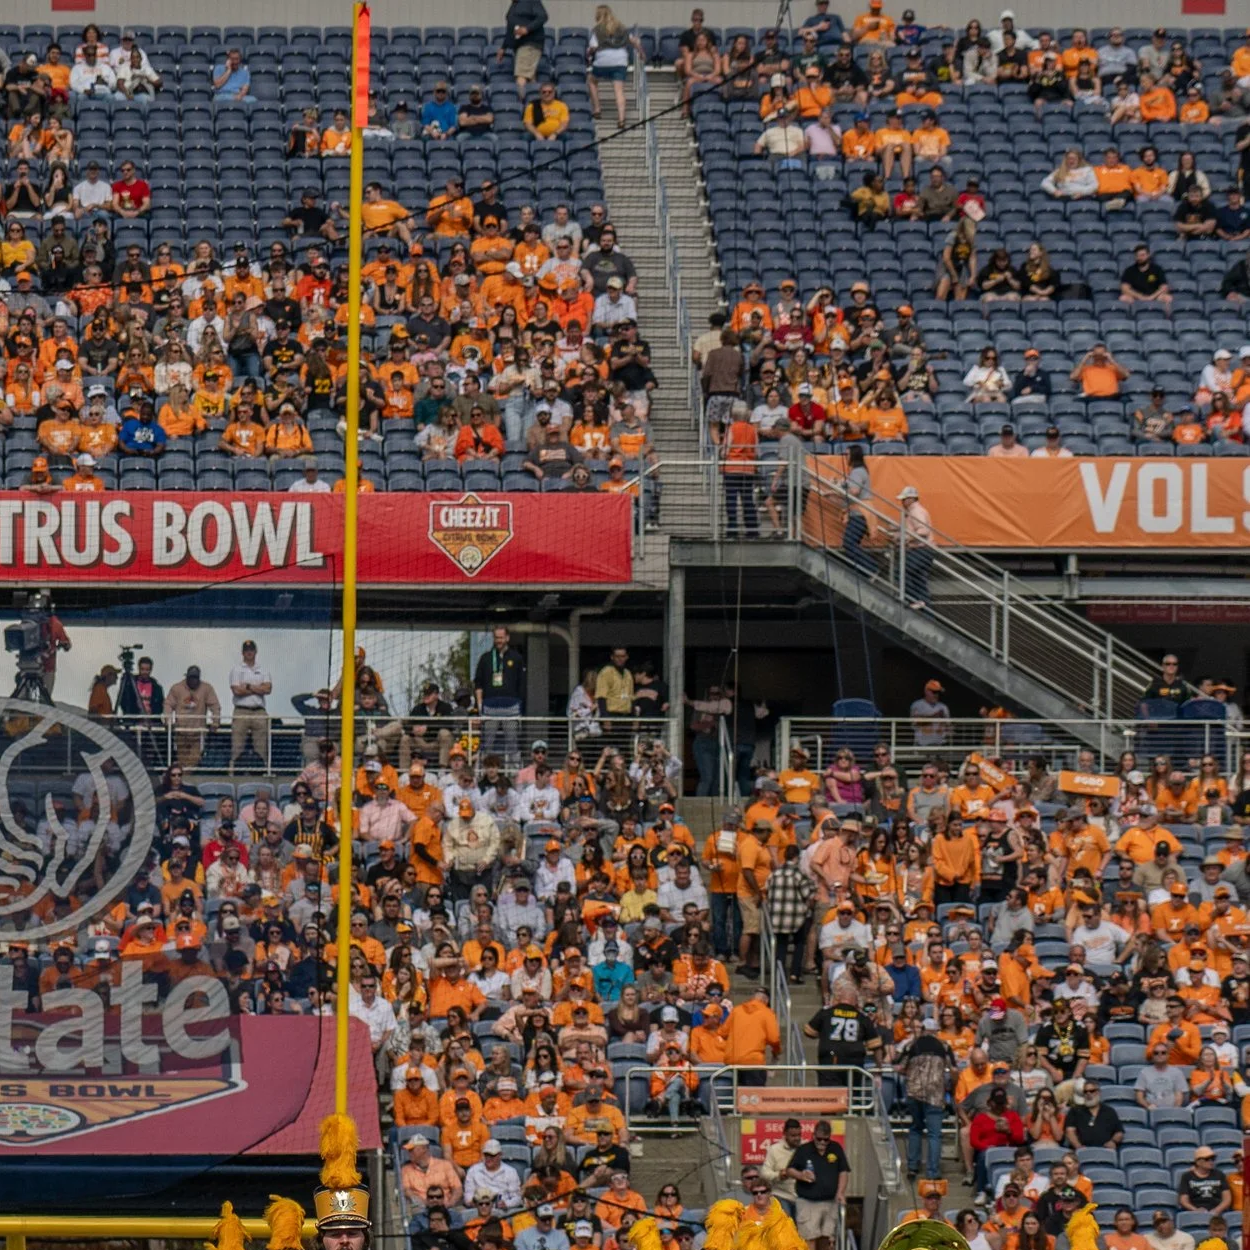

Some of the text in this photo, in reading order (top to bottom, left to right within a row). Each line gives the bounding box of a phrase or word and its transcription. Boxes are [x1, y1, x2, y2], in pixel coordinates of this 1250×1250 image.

[582, 431, 605, 449] 17
[152, 499, 324, 568] BOWL
[830, 1017, 859, 1042] 78
[48, 1083, 171, 1098] BOWL
[457, 1130, 472, 1146] T
